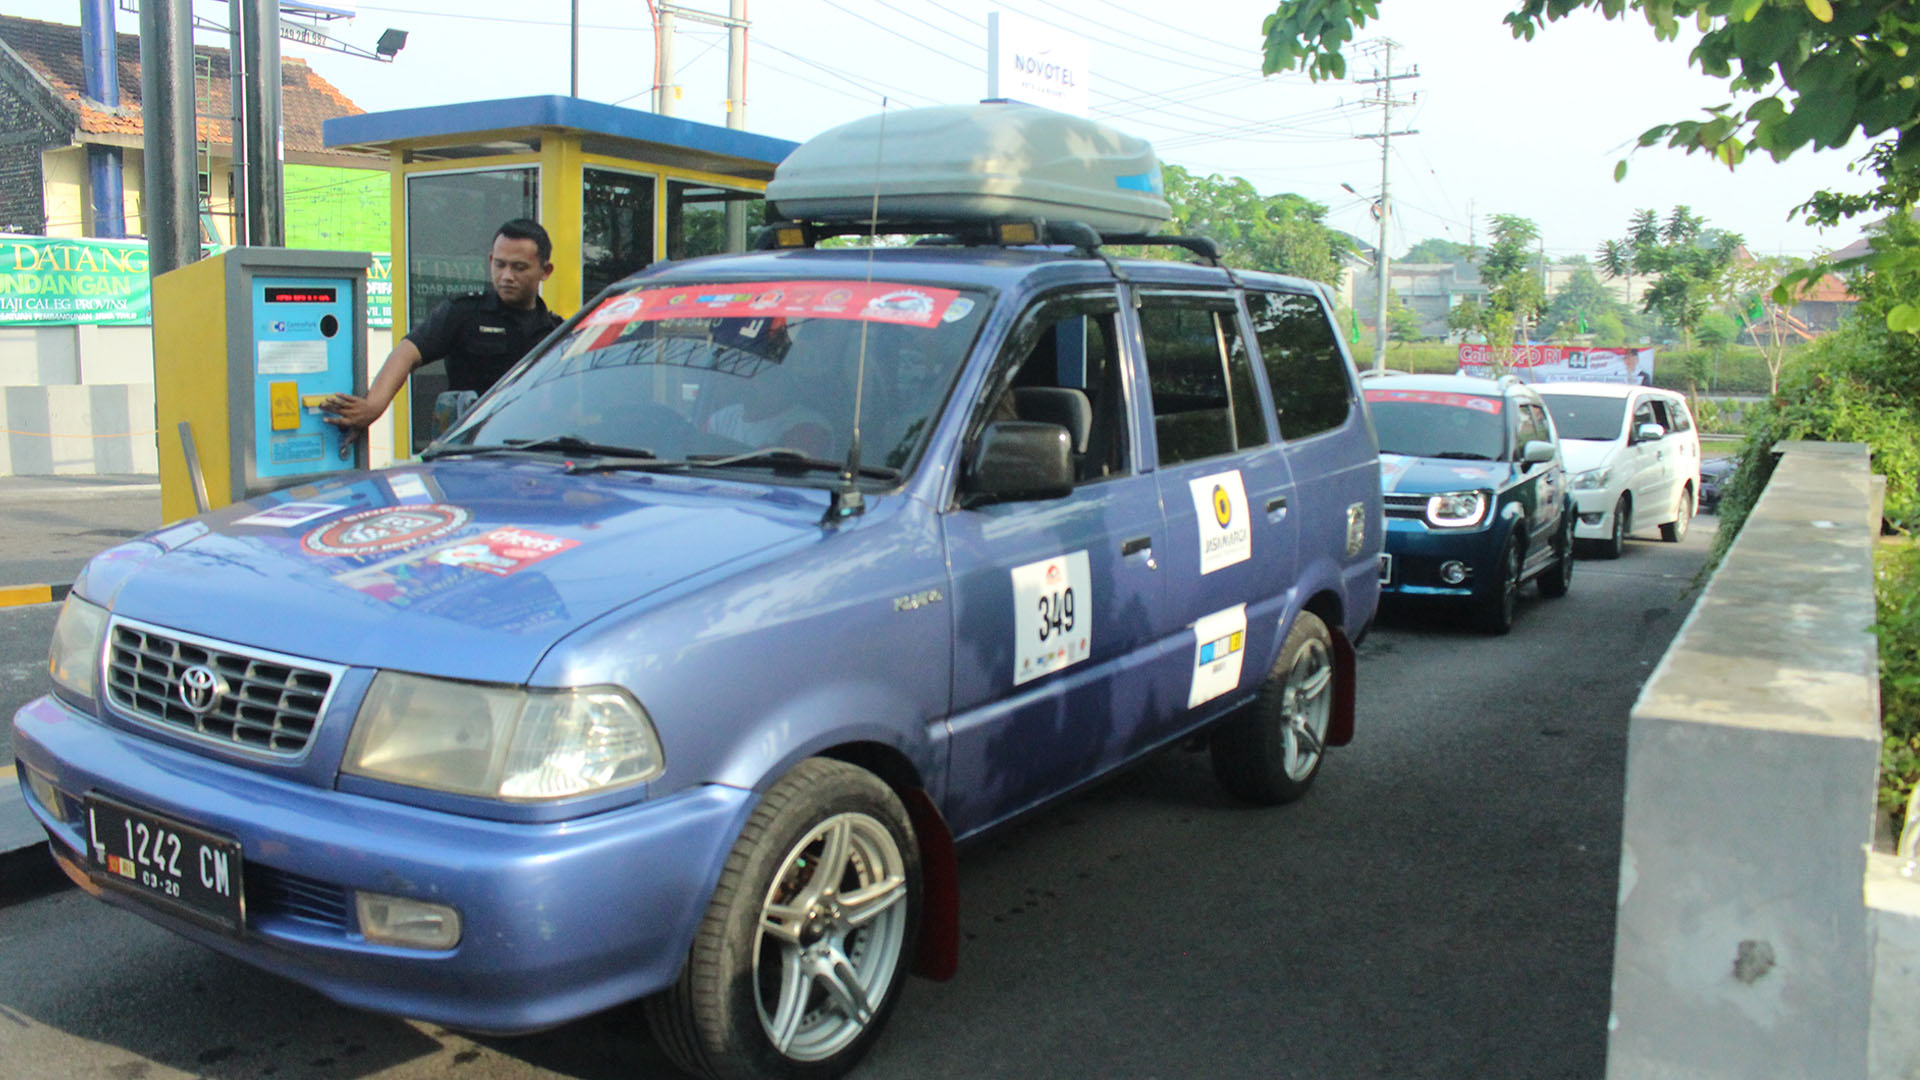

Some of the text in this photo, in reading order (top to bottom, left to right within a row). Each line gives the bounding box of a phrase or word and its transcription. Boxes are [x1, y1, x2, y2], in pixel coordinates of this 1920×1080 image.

[1015, 53, 1076, 87] NOVOTEL
[11, 244, 148, 273] DATANG
[75, 298, 129, 311] PROVINSI
[1569, 353, 1587, 367] 44
[1038, 587, 1075, 642] 349
[89, 807, 230, 897] L 1242 CM
